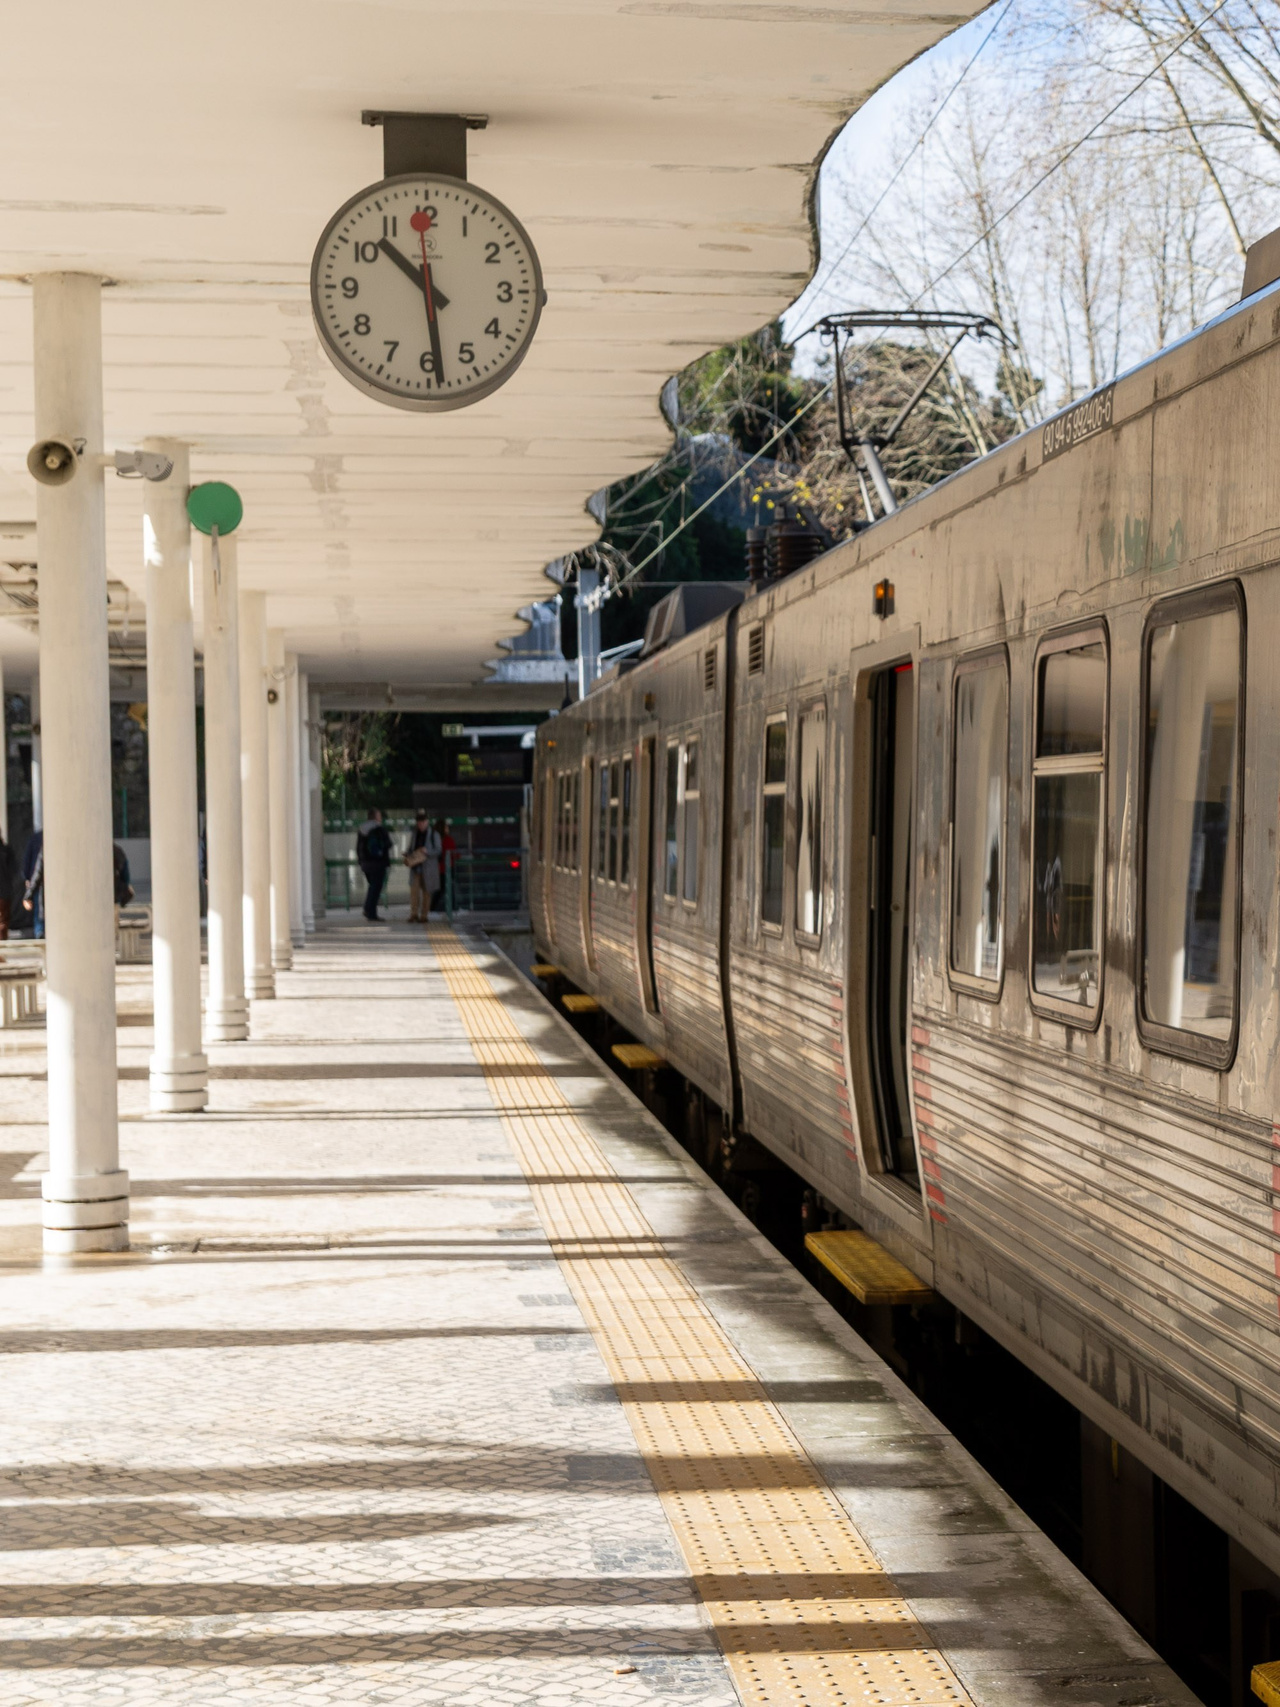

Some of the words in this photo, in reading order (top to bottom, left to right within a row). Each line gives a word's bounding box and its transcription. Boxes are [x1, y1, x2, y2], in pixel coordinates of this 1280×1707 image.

[383, 215, 397, 238] 11
[462, 215, 468, 238] 1
[354, 241, 379, 263] 10
[484, 242, 501, 264] 2
[341, 277, 359, 299] 9
[496, 281, 514, 303] 3
[353, 313, 371, 336] 8
[484, 317, 502, 339] 4
[383, 341, 399, 362] 7
[419, 351, 436, 373] 6
[458, 342, 475, 364] 5
